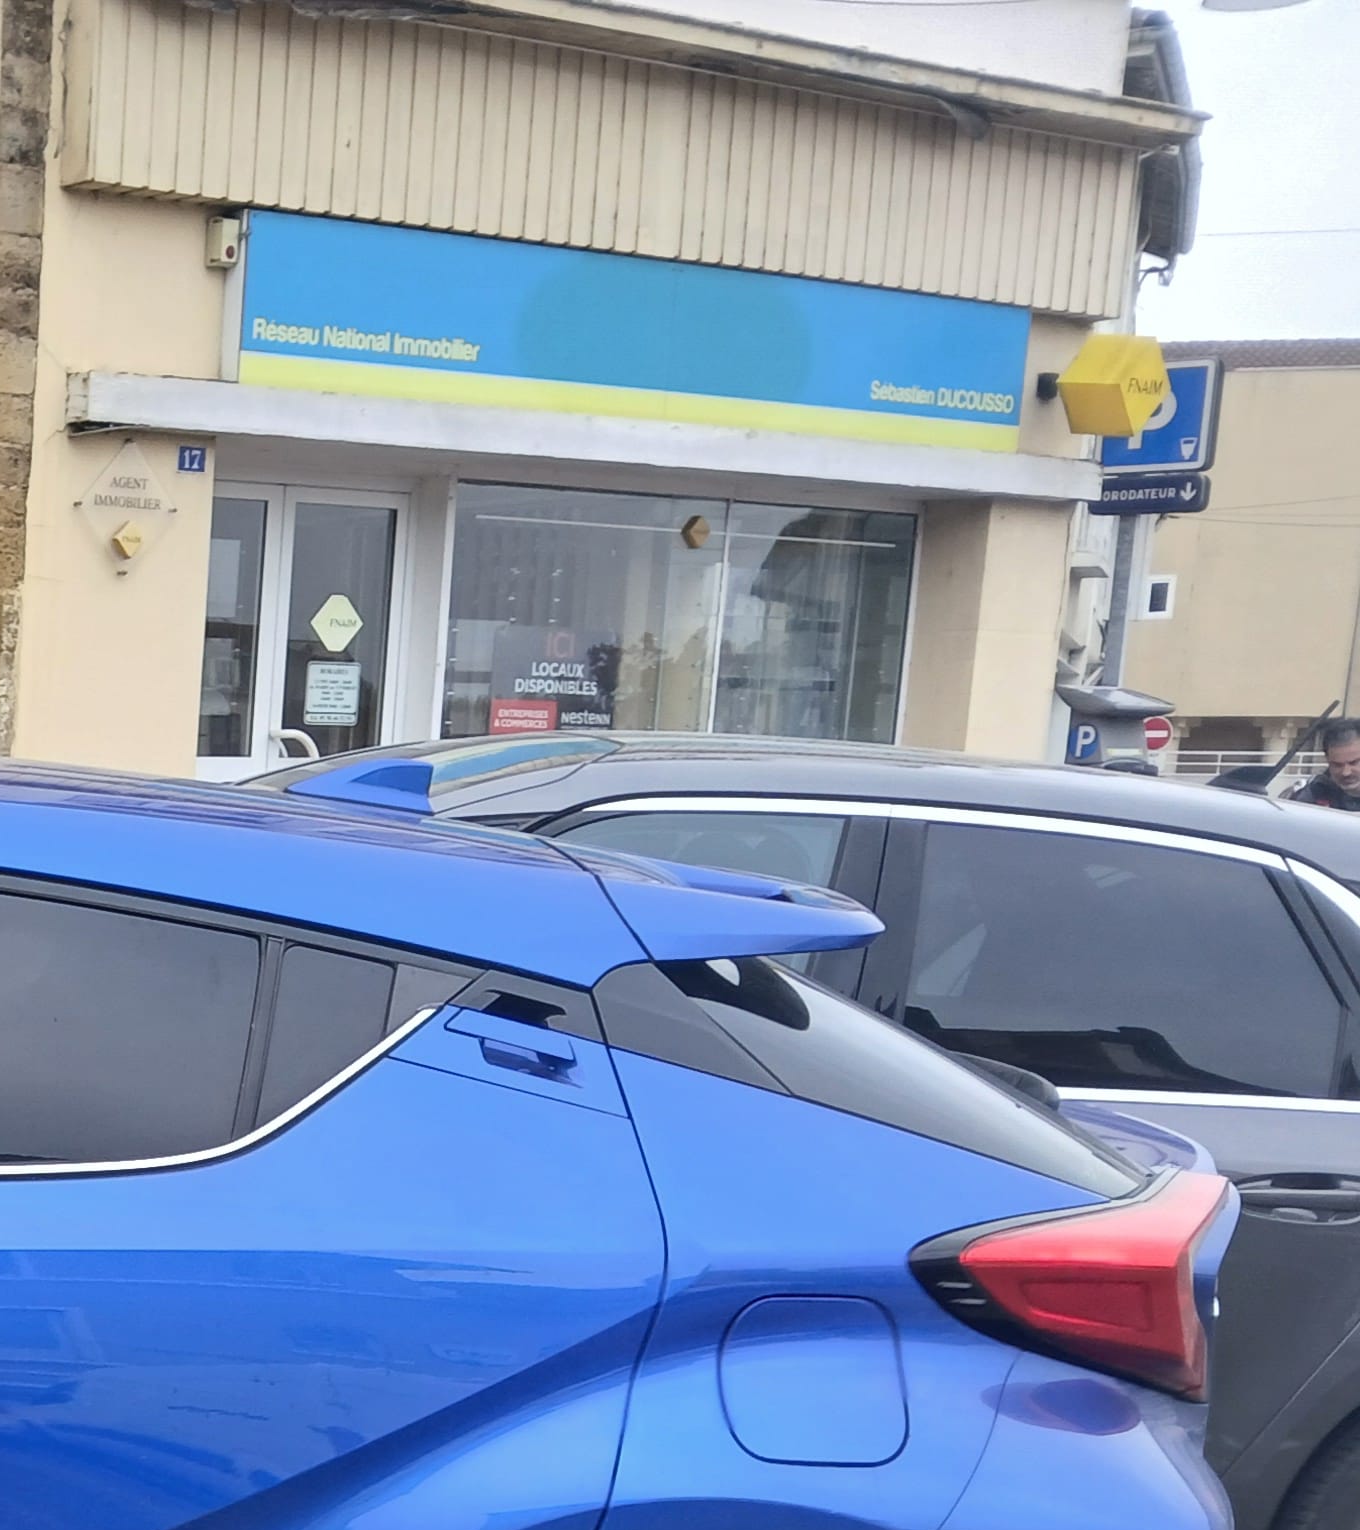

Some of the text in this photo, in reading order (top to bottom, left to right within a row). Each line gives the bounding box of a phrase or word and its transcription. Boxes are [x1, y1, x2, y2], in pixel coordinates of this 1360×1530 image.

[252, 317, 481, 361] Réseau National Immobilier
[1127, 377, 1163, 396] FNAIM
[871, 380, 1014, 414] Sébastien DUCOUSSO
[183, 449, 202, 469] 17
[110, 476, 149, 490] AGENT
[93, 494, 161, 510] IMMOBILIER
[1103, 487, 1176, 501] ORODATEUR
[546, 631, 576, 658] ICI
[531, 662, 585, 678] LOCAUX
[514, 678, 598, 696] DISPONIBLES
[1075, 725, 1096, 758] P
